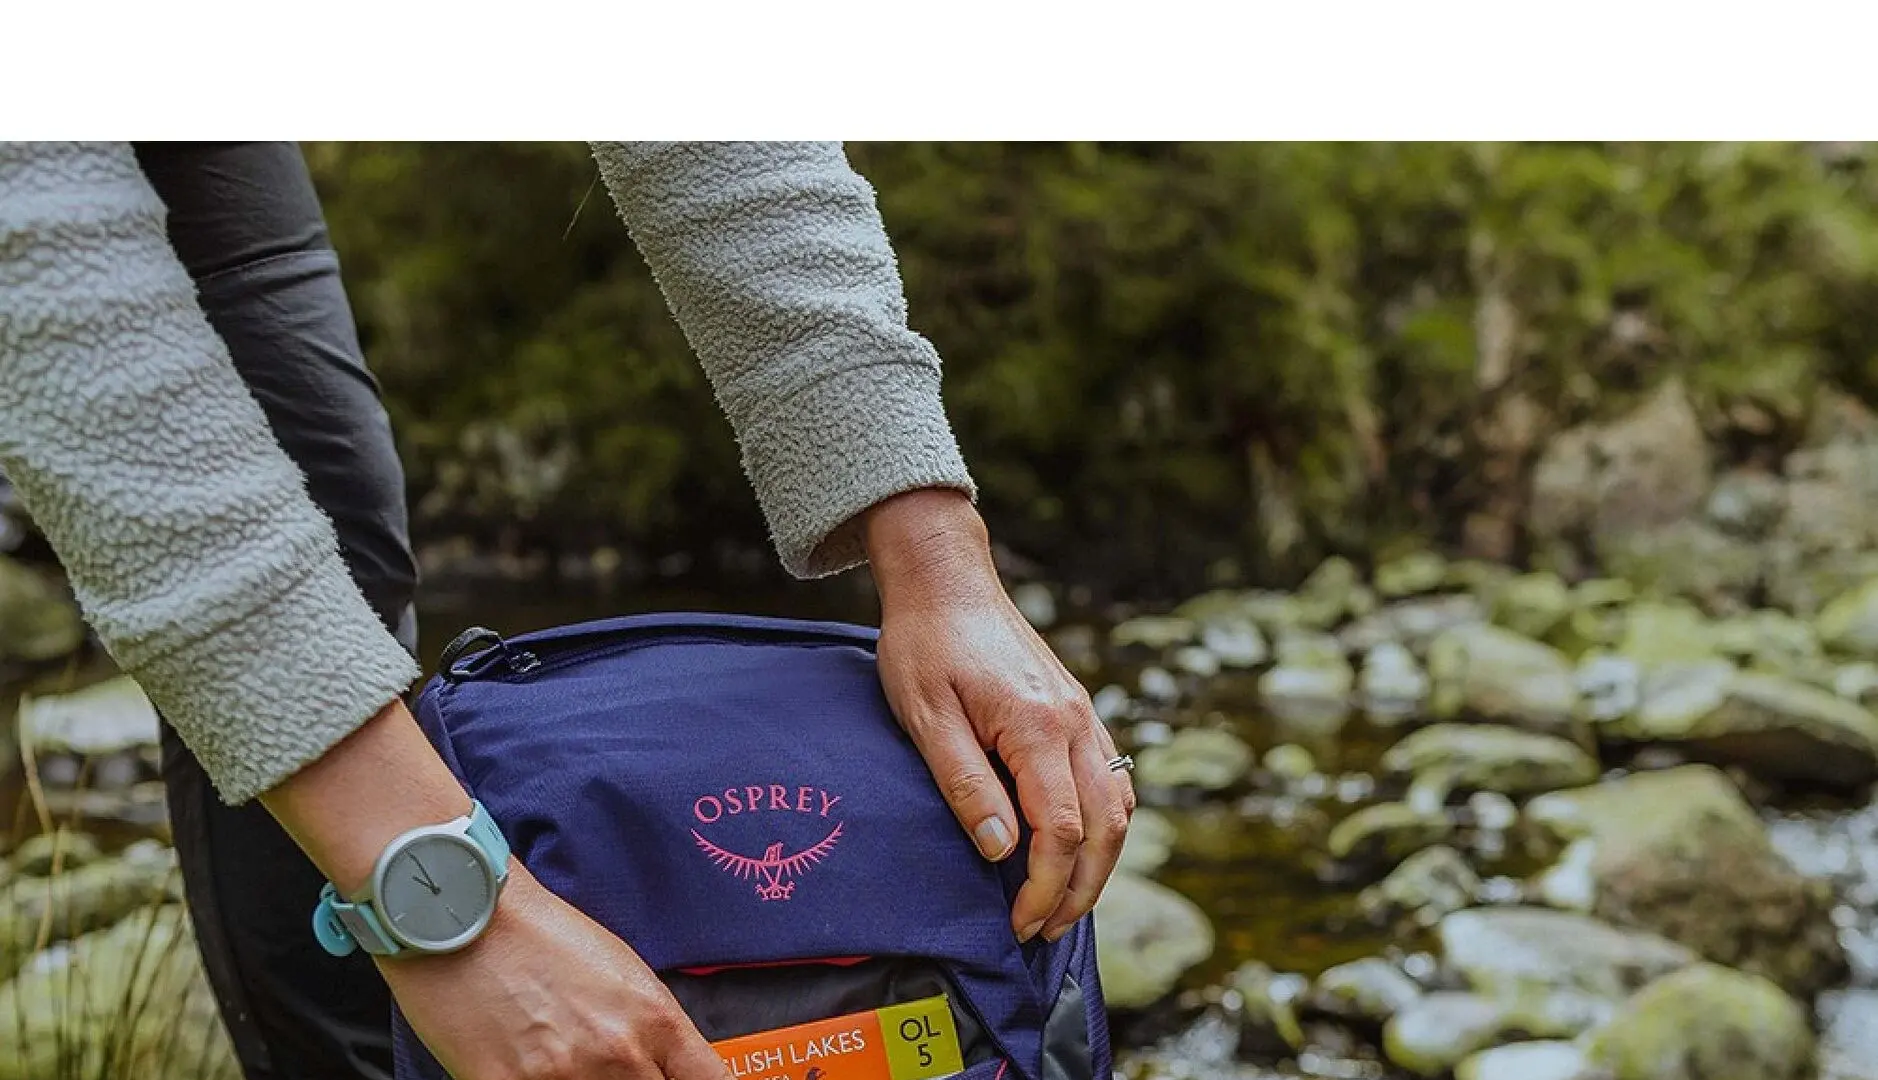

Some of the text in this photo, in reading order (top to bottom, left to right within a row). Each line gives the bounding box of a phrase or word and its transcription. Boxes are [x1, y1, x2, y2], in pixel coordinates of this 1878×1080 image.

[694, 784, 842, 824] OSPREY
[900, 1015, 941, 1042] OL
[723, 1029, 866, 1077] LISH LAKES
[917, 1043, 933, 1068] 5
